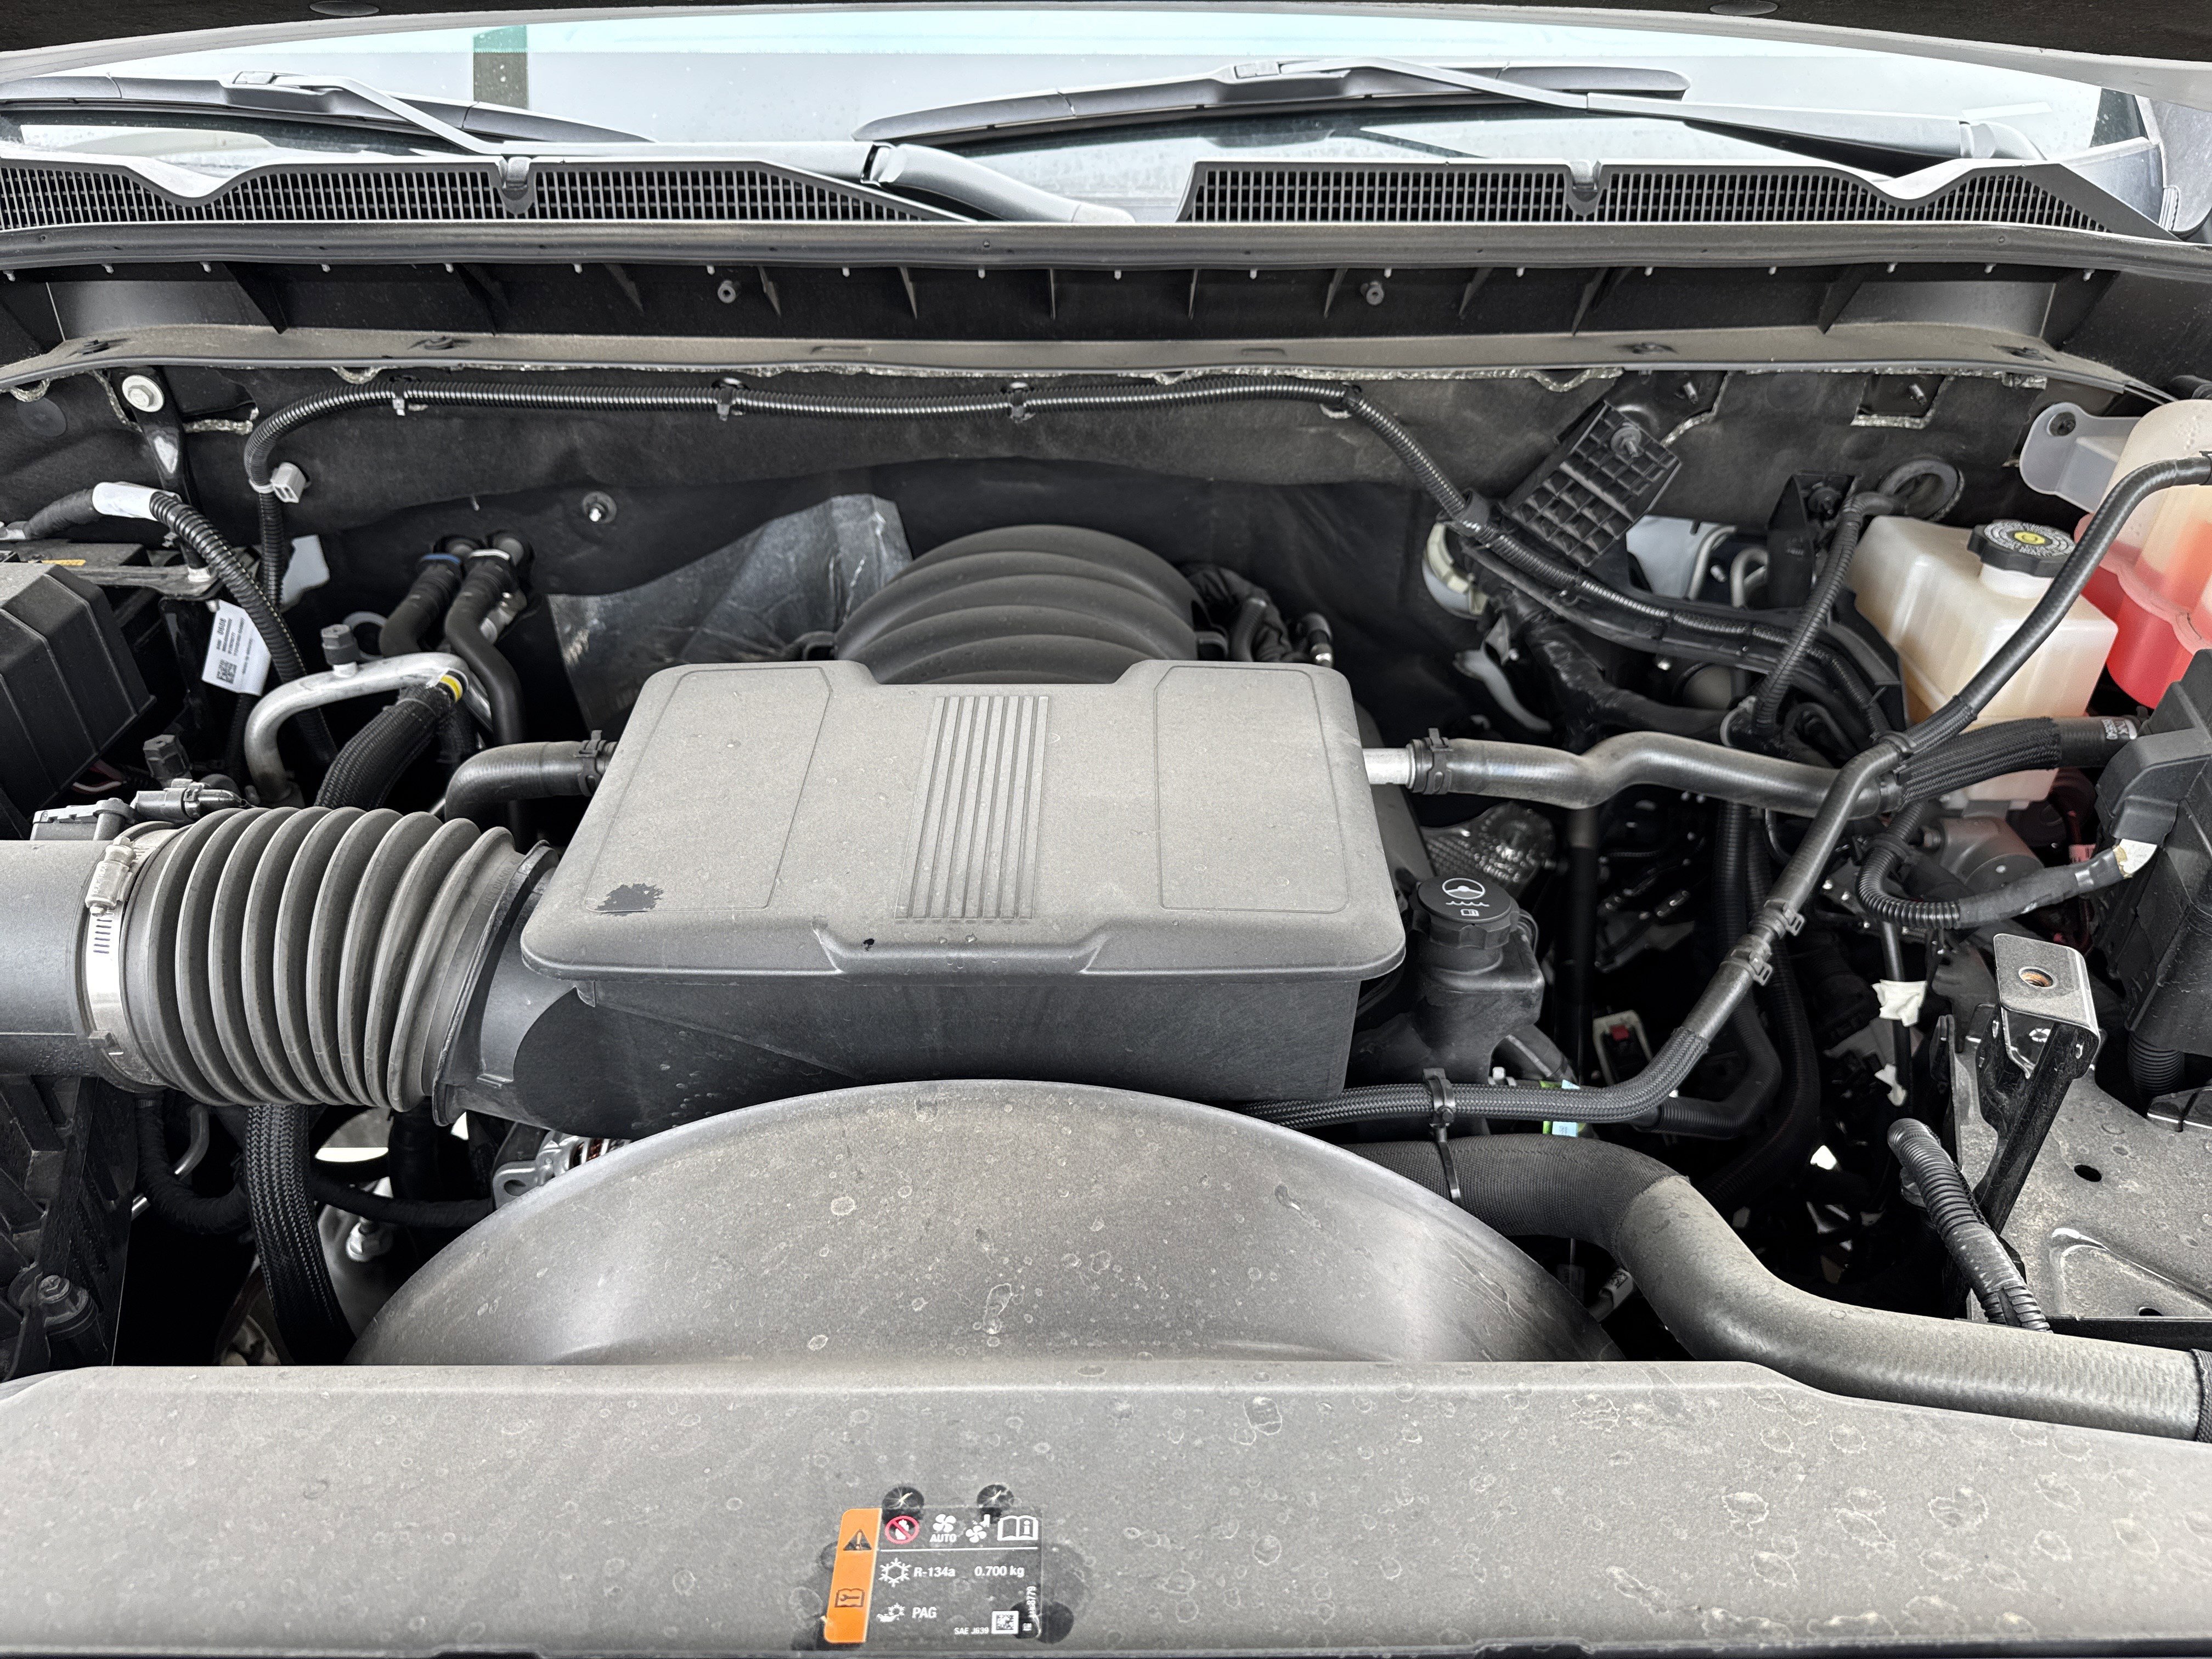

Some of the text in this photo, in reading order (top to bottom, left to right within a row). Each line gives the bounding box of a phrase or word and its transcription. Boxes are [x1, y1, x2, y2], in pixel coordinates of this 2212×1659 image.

[929, 1533, 957, 1543] AUTO
[913, 1565, 1025, 1578] R-134a 0.700 kg
[911, 1607, 937, 1619] PAG
[971, 1627, 989, 1635] J639
